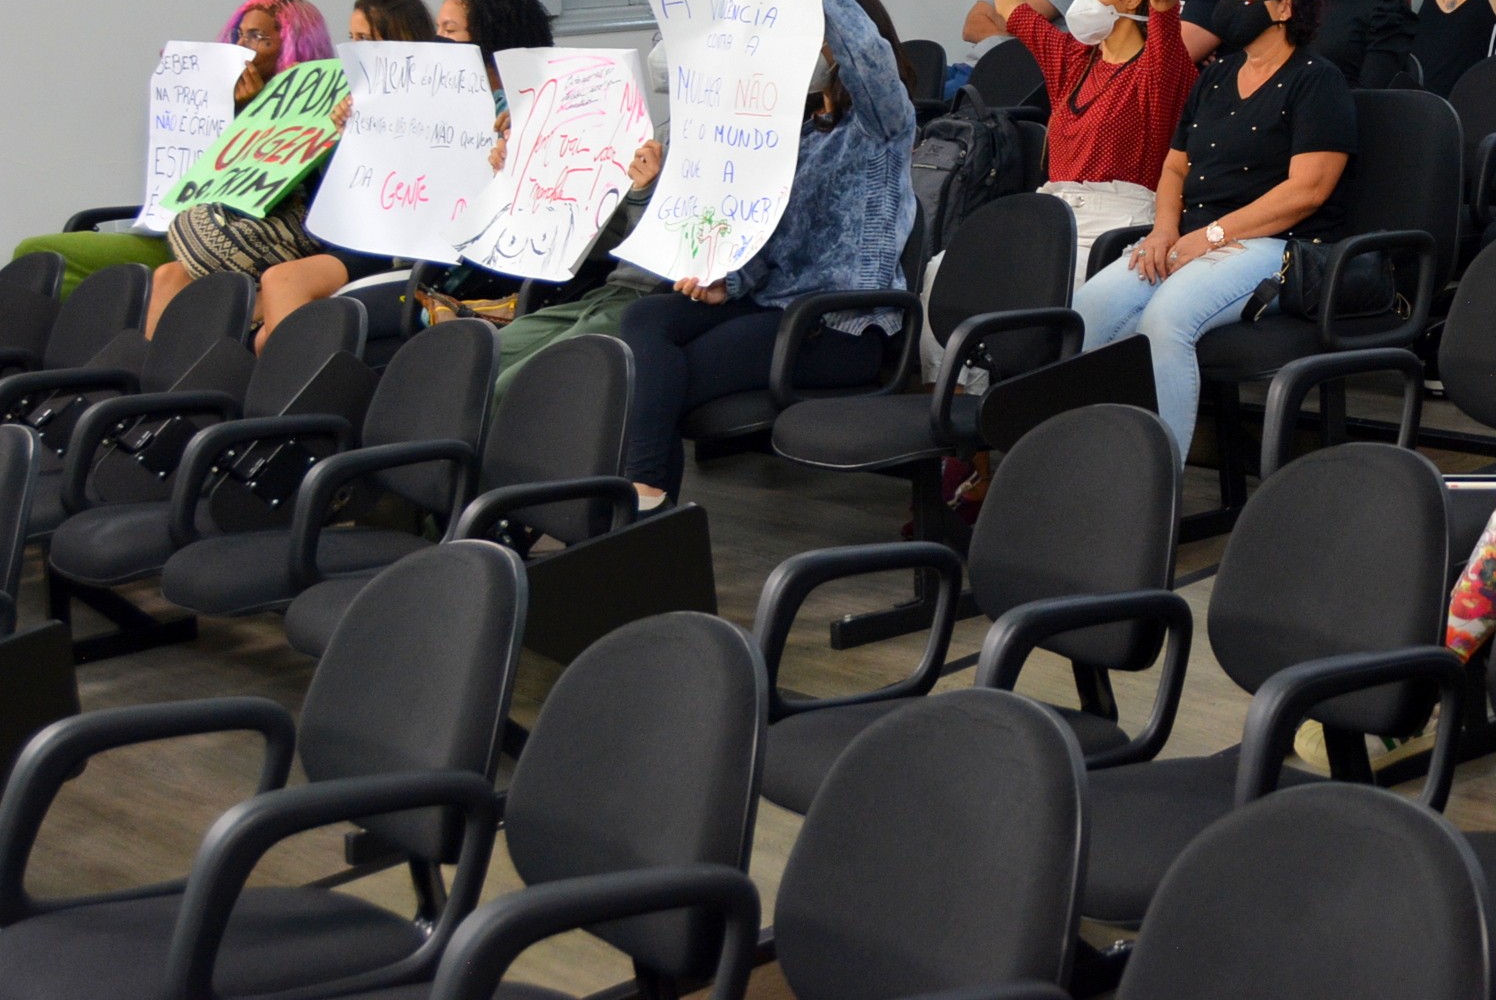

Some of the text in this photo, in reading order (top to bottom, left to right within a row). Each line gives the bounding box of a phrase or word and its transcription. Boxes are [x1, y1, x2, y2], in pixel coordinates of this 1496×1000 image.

[155, 86, 208, 113] NA PRAÇA
[735, 73, 778, 111] NÃO
[156, 110, 176, 131] NÃO
[714, 125, 778, 150] MUNDO
[723, 161, 734, 183] A
